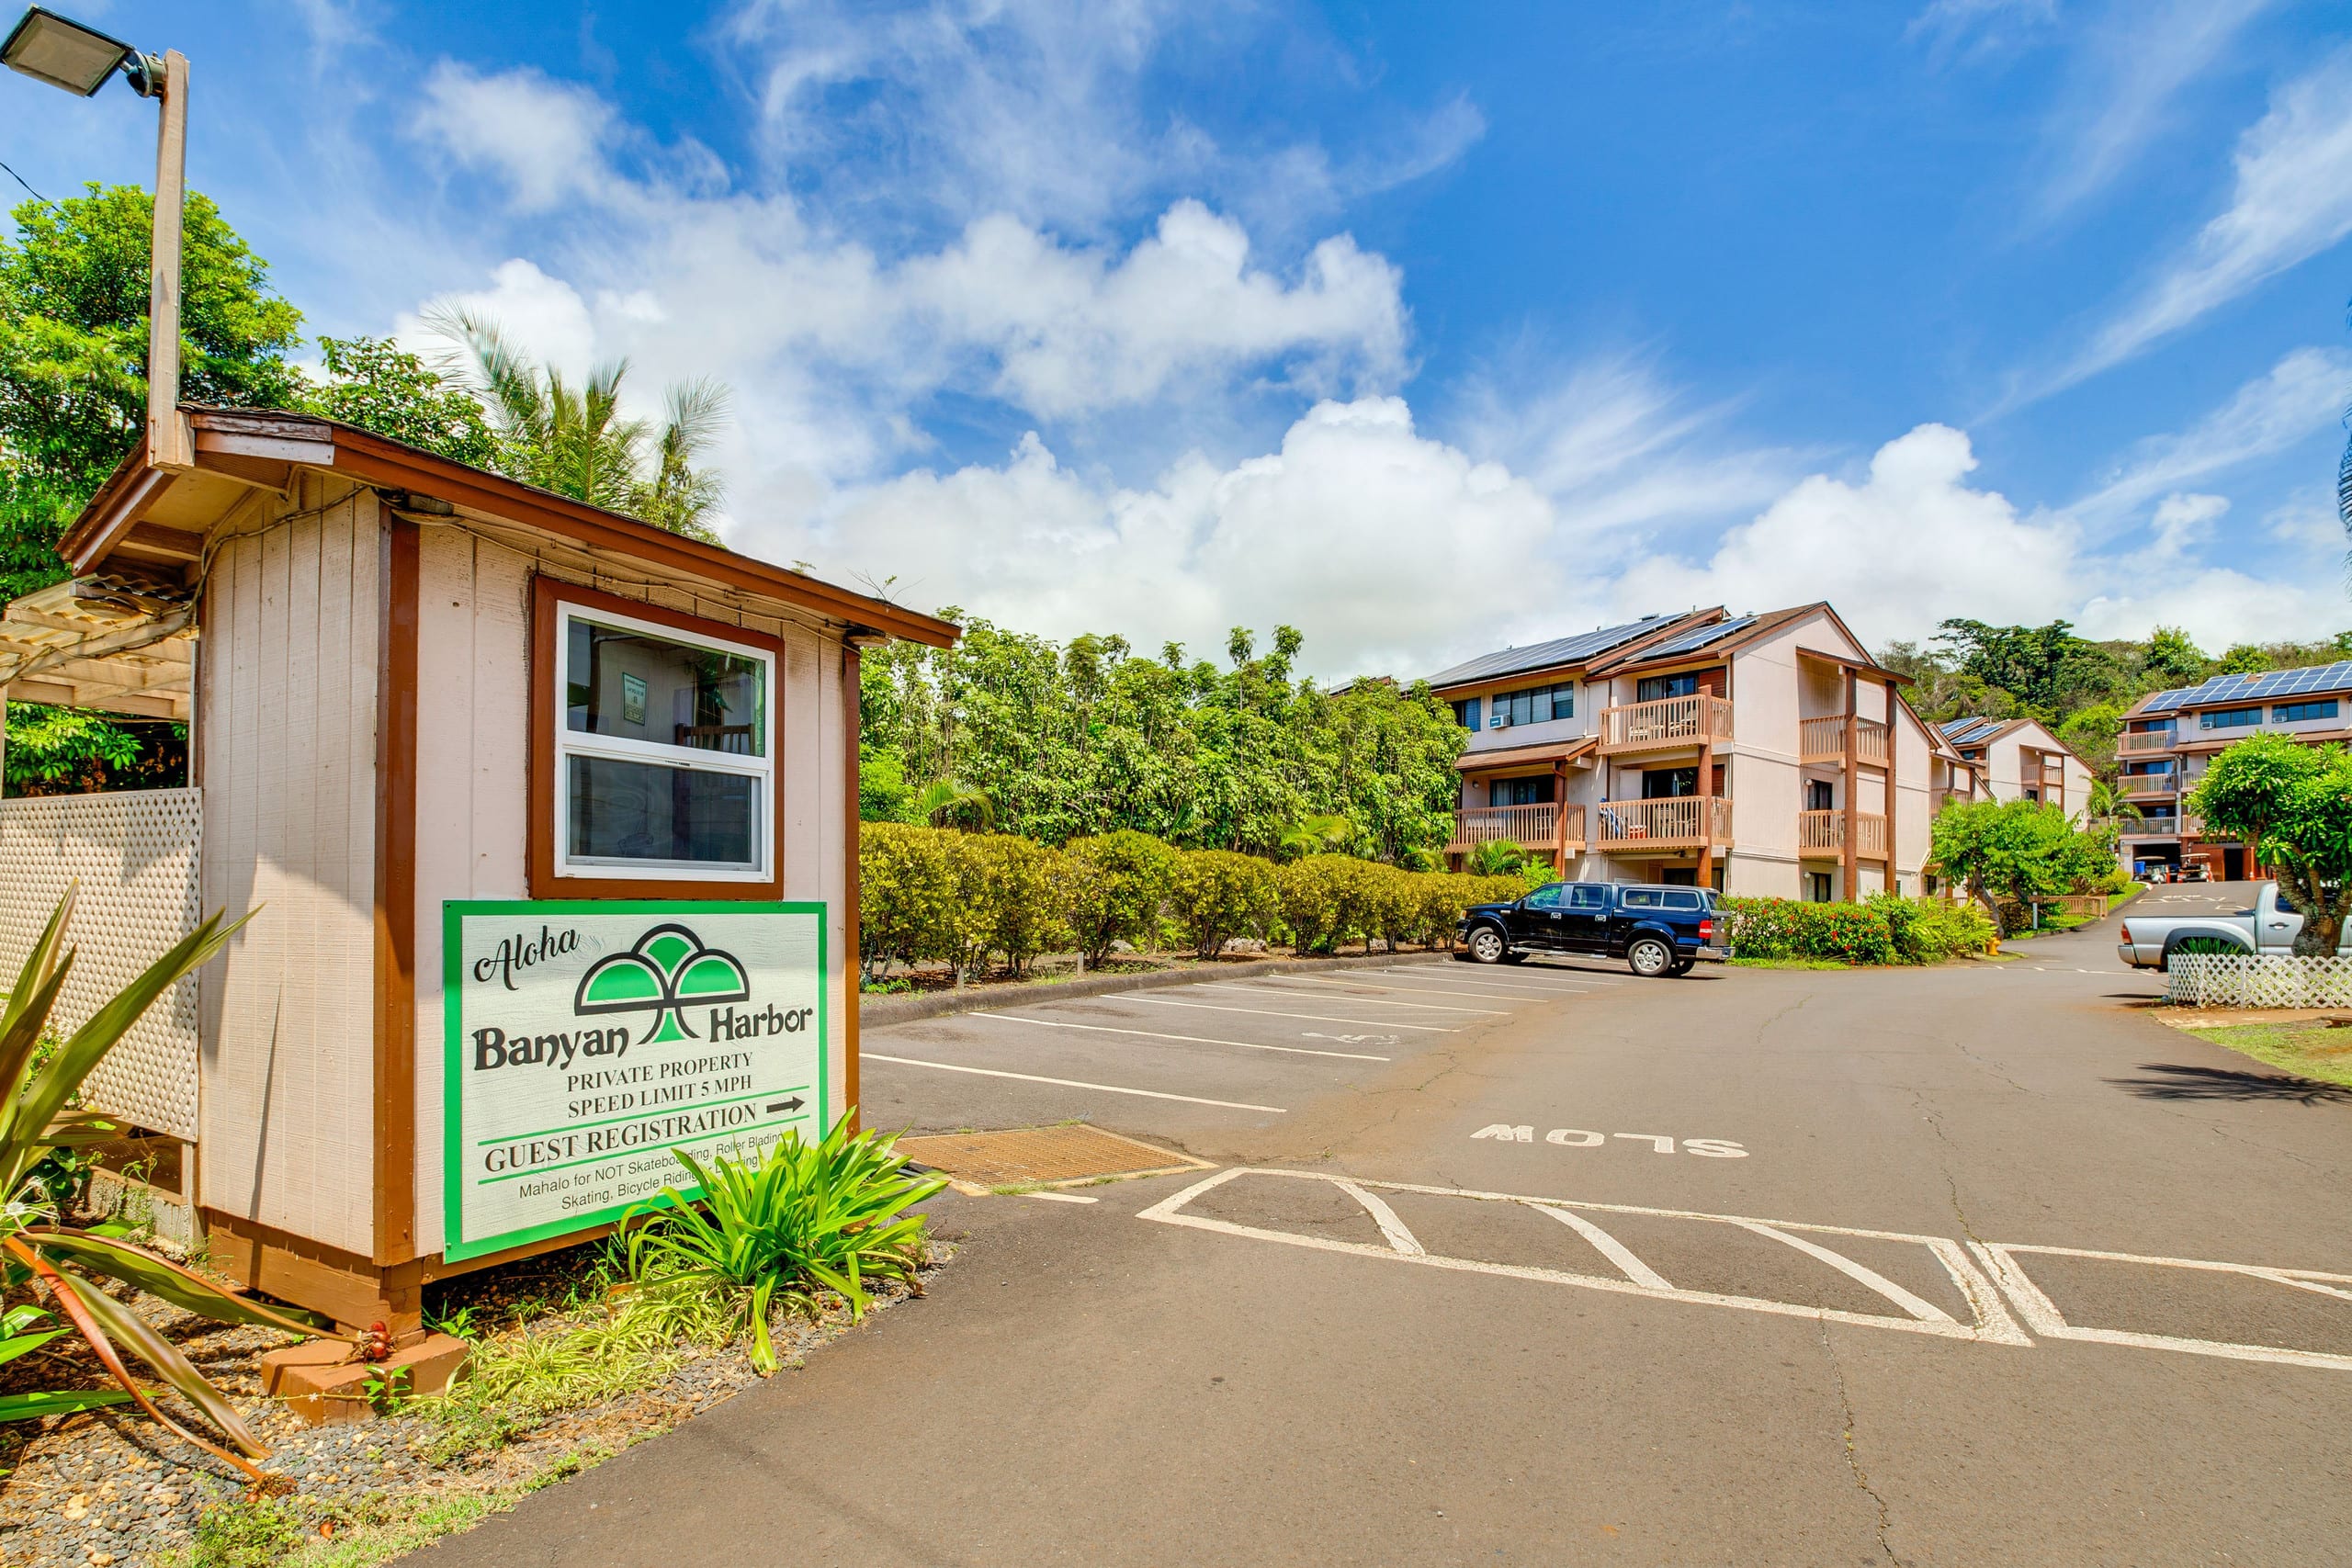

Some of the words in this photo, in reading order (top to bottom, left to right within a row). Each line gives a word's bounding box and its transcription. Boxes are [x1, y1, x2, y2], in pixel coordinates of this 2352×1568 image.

[474, 925, 580, 991] Aloha
[471, 1027, 629, 1071] Banyan
[709, 1002, 813, 1043] Harbor
[567, 1066, 653, 1092] PRIVATE
[660, 1052, 753, 1079] PROPERTY
[568, 1093, 634, 1119] SPEED
[640, 1084, 695, 1106] LIMIT
[701, 1080, 710, 1097] 5
[714, 1075, 752, 1095] MPH
[485, 1134, 579, 1172] GUEST
[586, 1103, 757, 1154] REGISTRATION
[1470, 1124, 1749, 1157] SLOW
[519, 1178, 570, 1199] Mahalo
[574, 1174, 591, 1186] for
[595, 1164, 624, 1182] NOT
[717, 1141, 745, 1155] Roller
[617, 1178, 660, 1197] Bicycle
